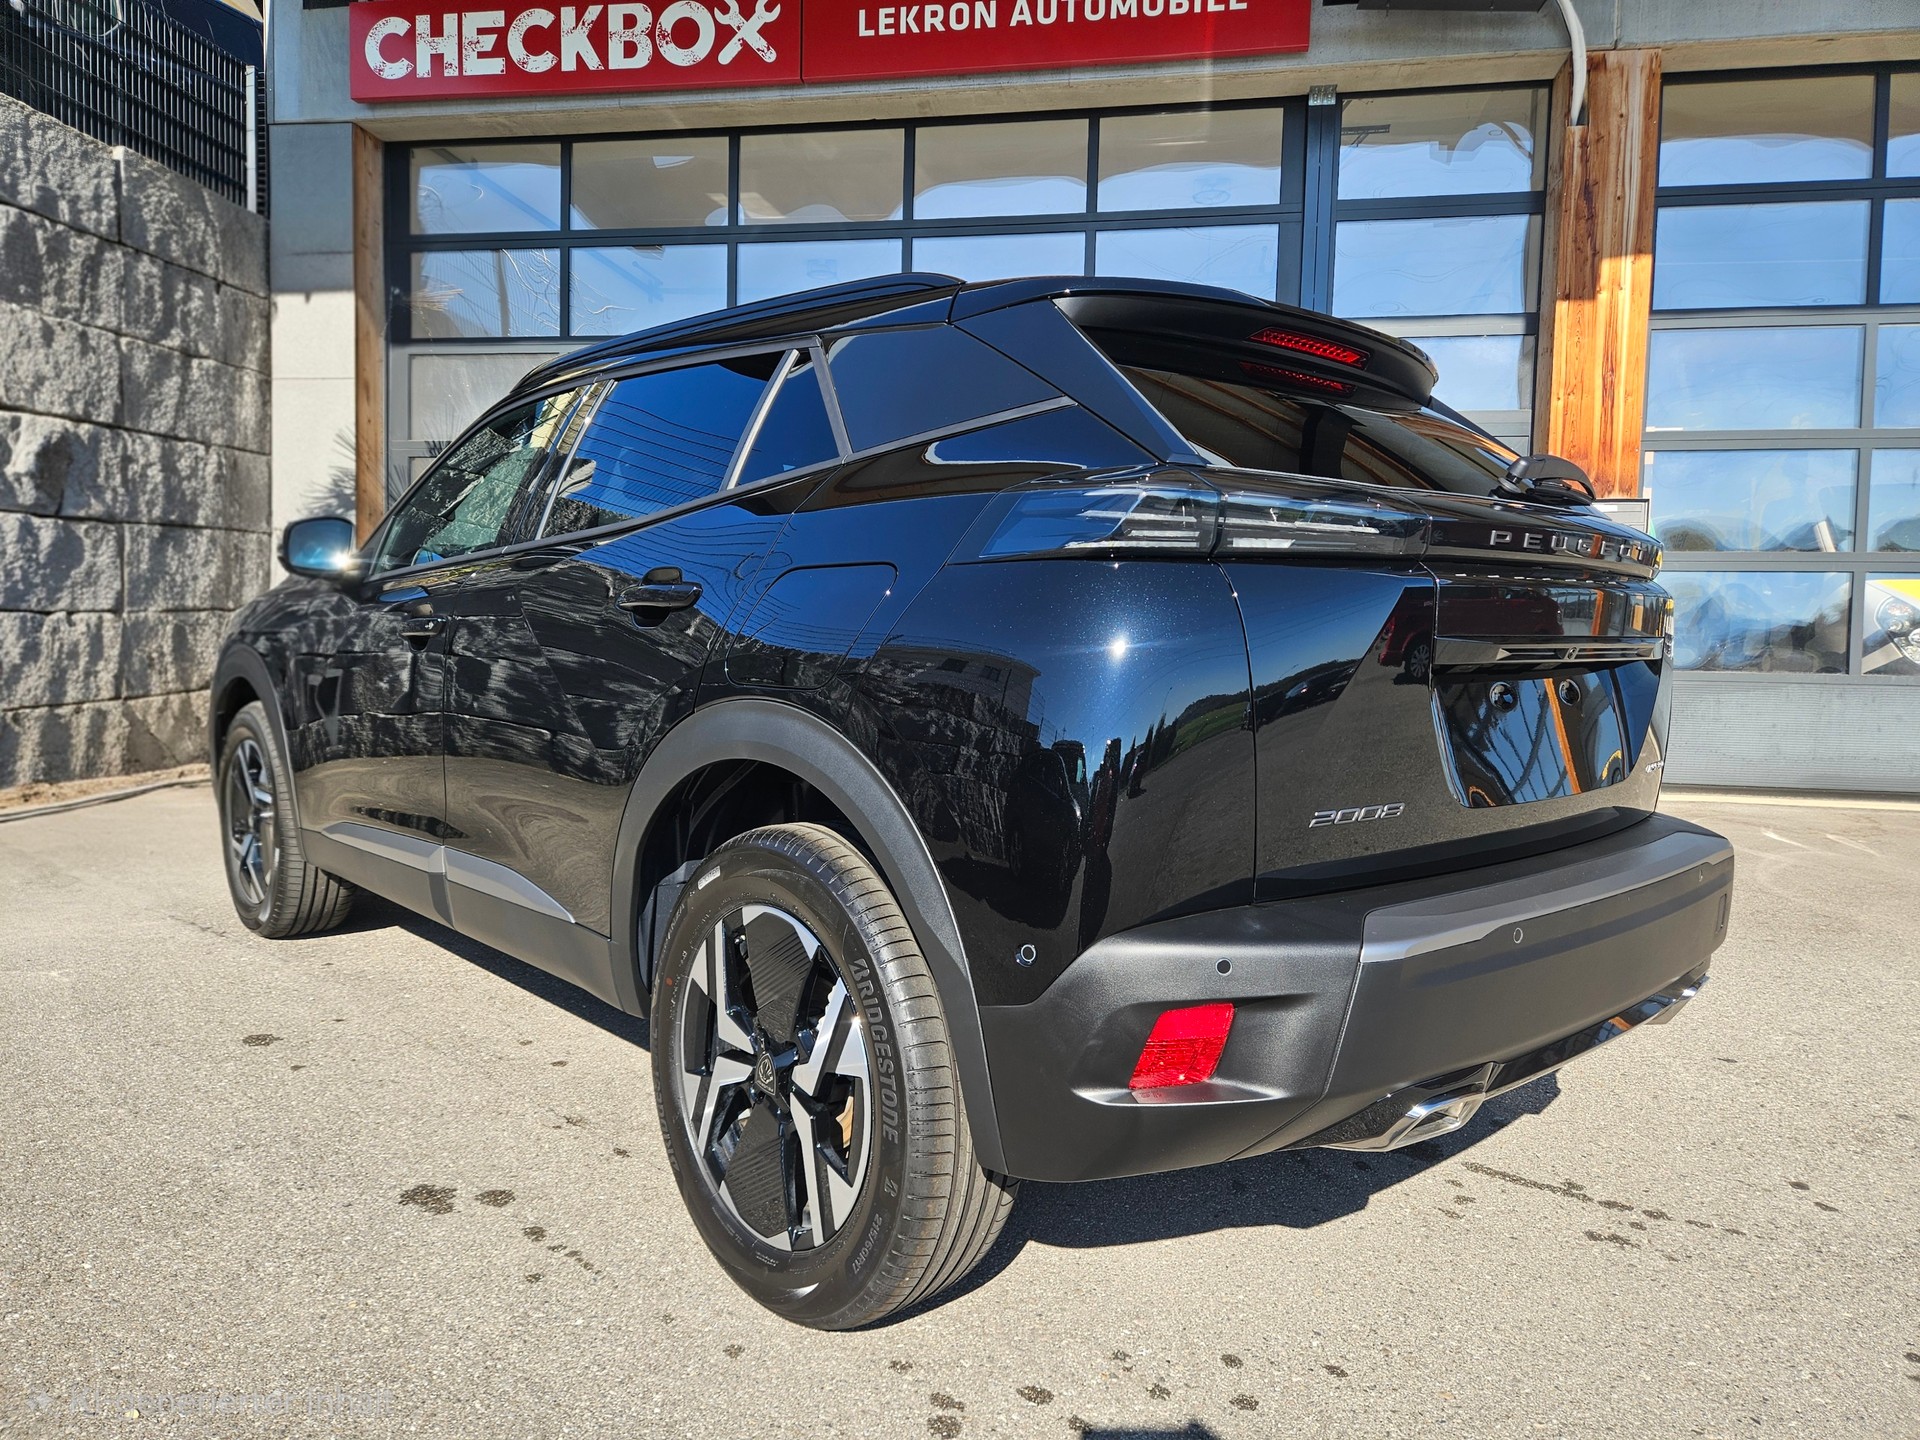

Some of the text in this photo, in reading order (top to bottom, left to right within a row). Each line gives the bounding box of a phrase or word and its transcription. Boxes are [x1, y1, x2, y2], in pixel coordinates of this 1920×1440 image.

[858, 0, 997, 37] LEKRON
[364, 0, 782, 80] CHECKBOX
[1489, 529, 1646, 561] PEUGEOT
[1308, 802, 1405, 828] 2008
[849, 958, 899, 1145] BRIDGESTONE
